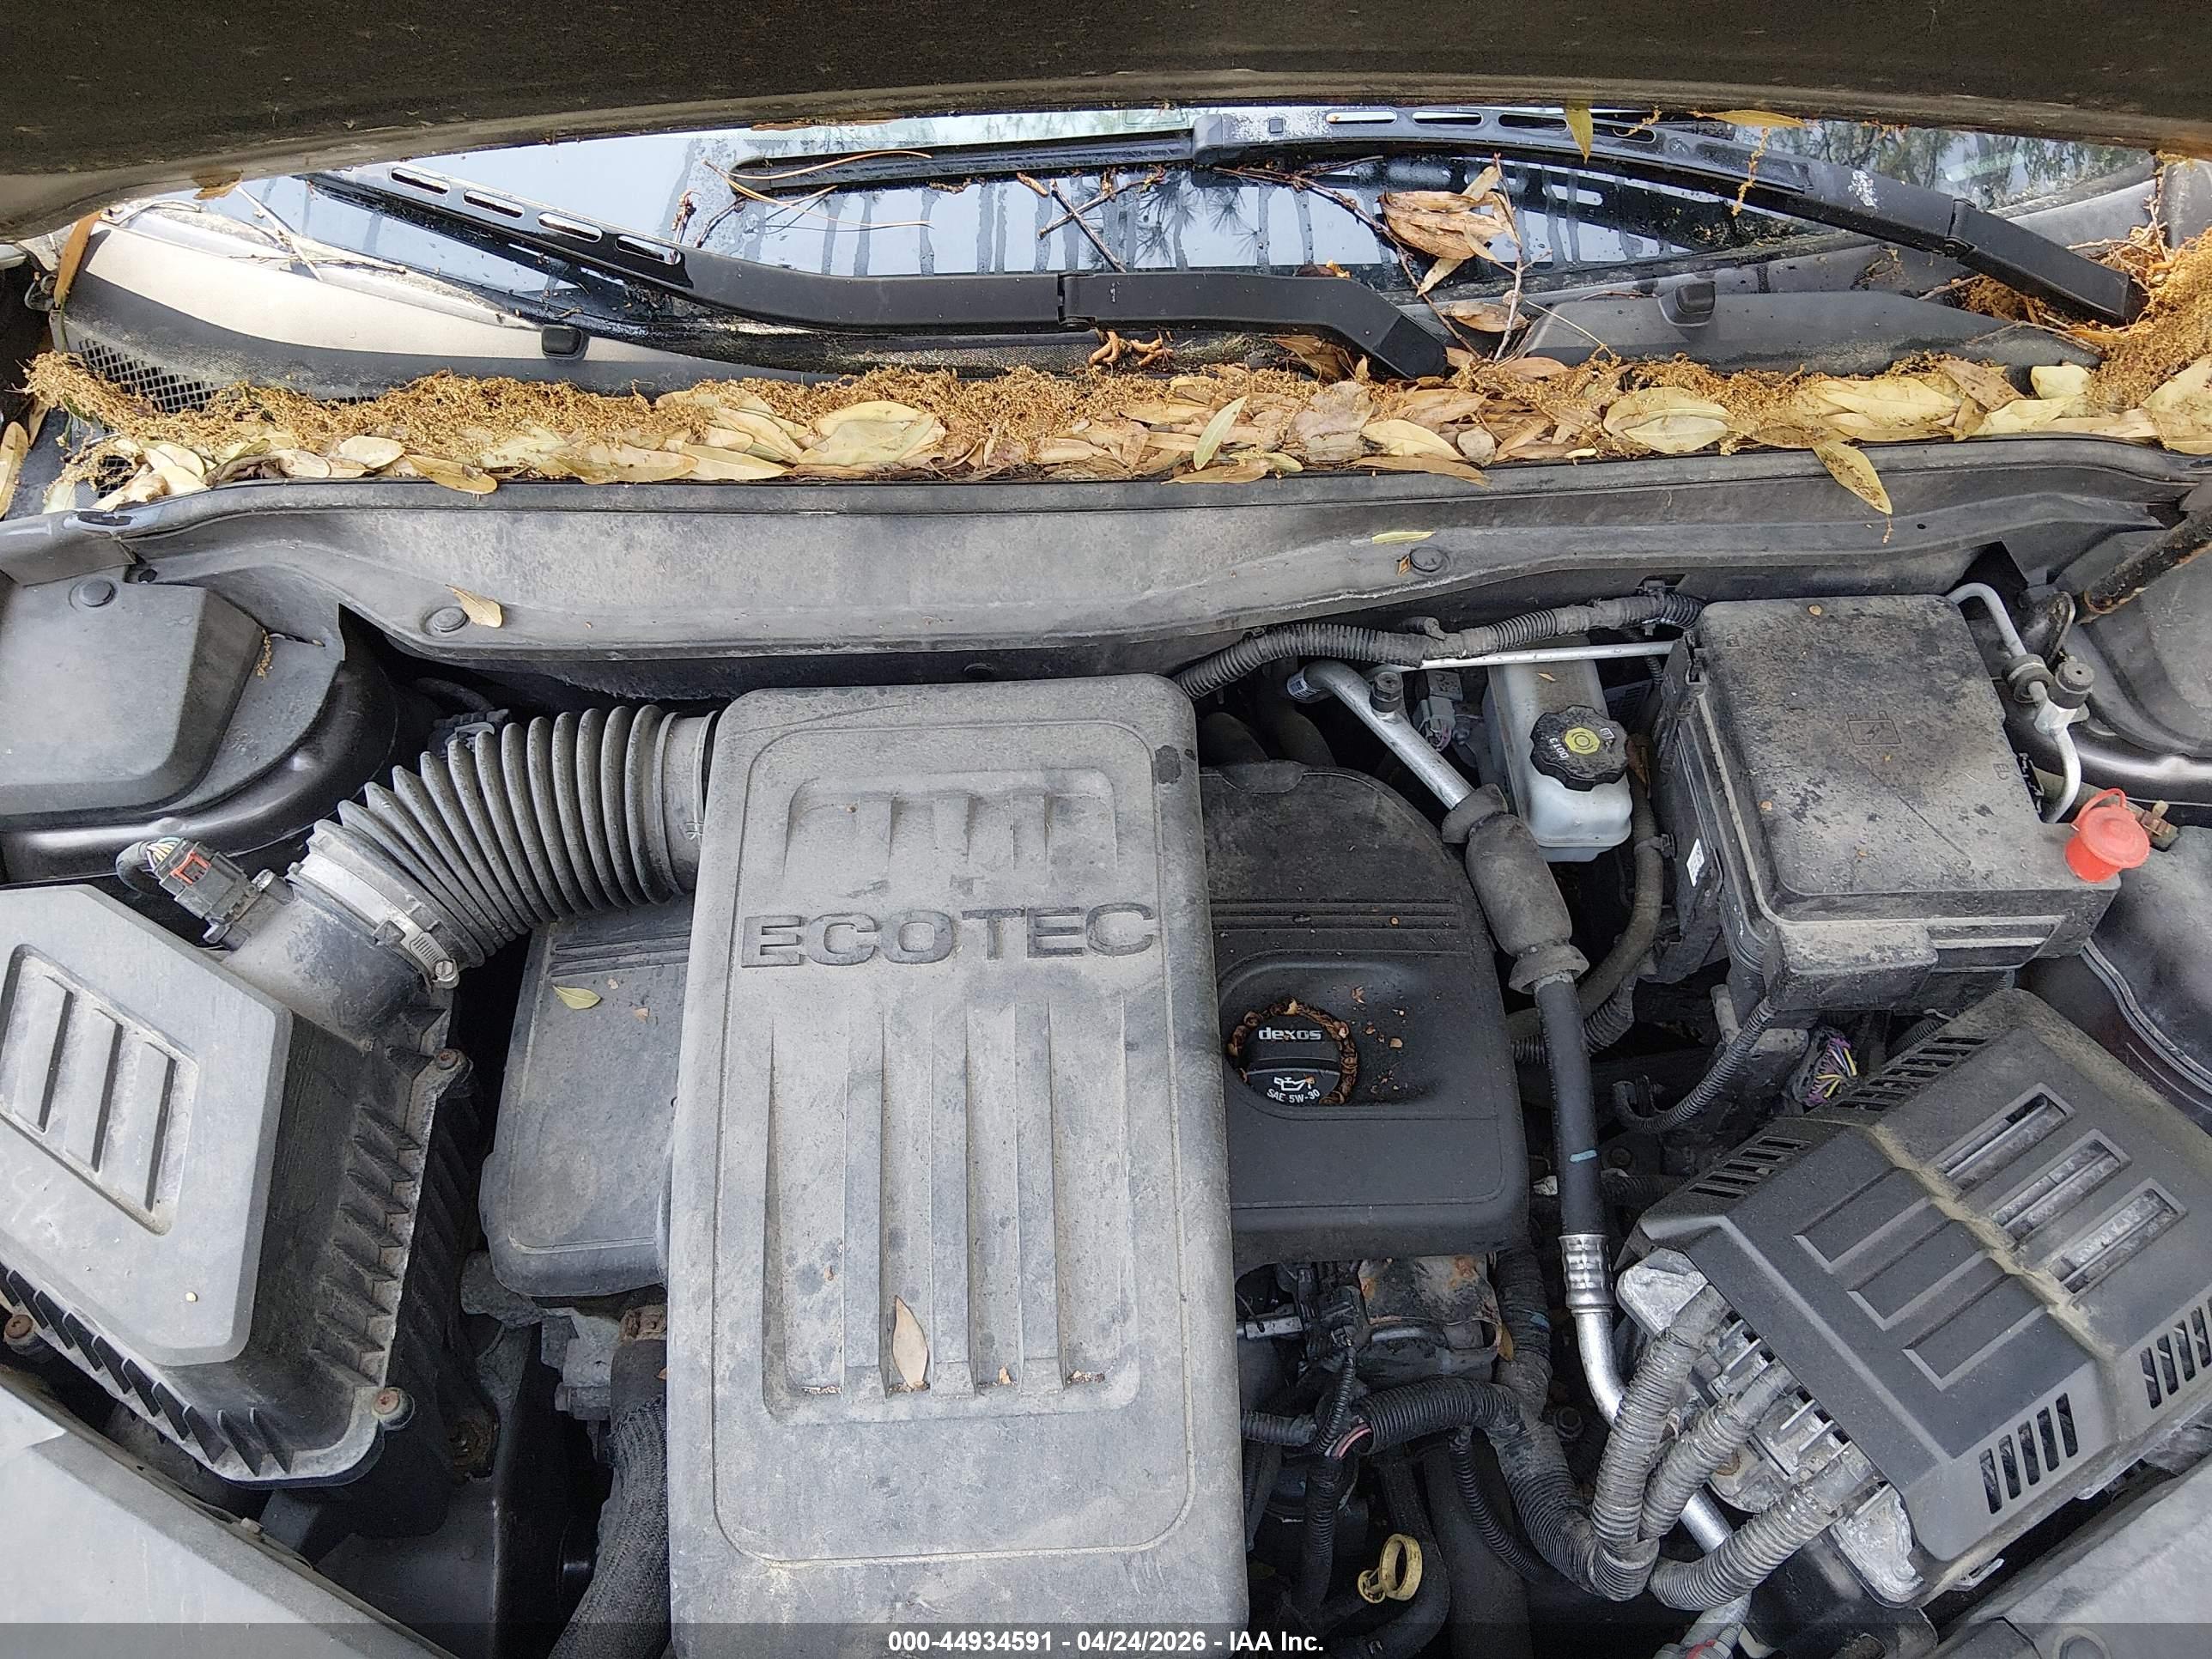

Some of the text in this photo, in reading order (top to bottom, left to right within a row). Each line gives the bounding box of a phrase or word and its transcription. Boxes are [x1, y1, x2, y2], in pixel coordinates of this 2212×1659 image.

[741, 902, 1156, 968] ECOTEC
[1258, 1026, 1322, 1041] dexos
[1267, 1088, 1321, 1103] SAE 5W-30
